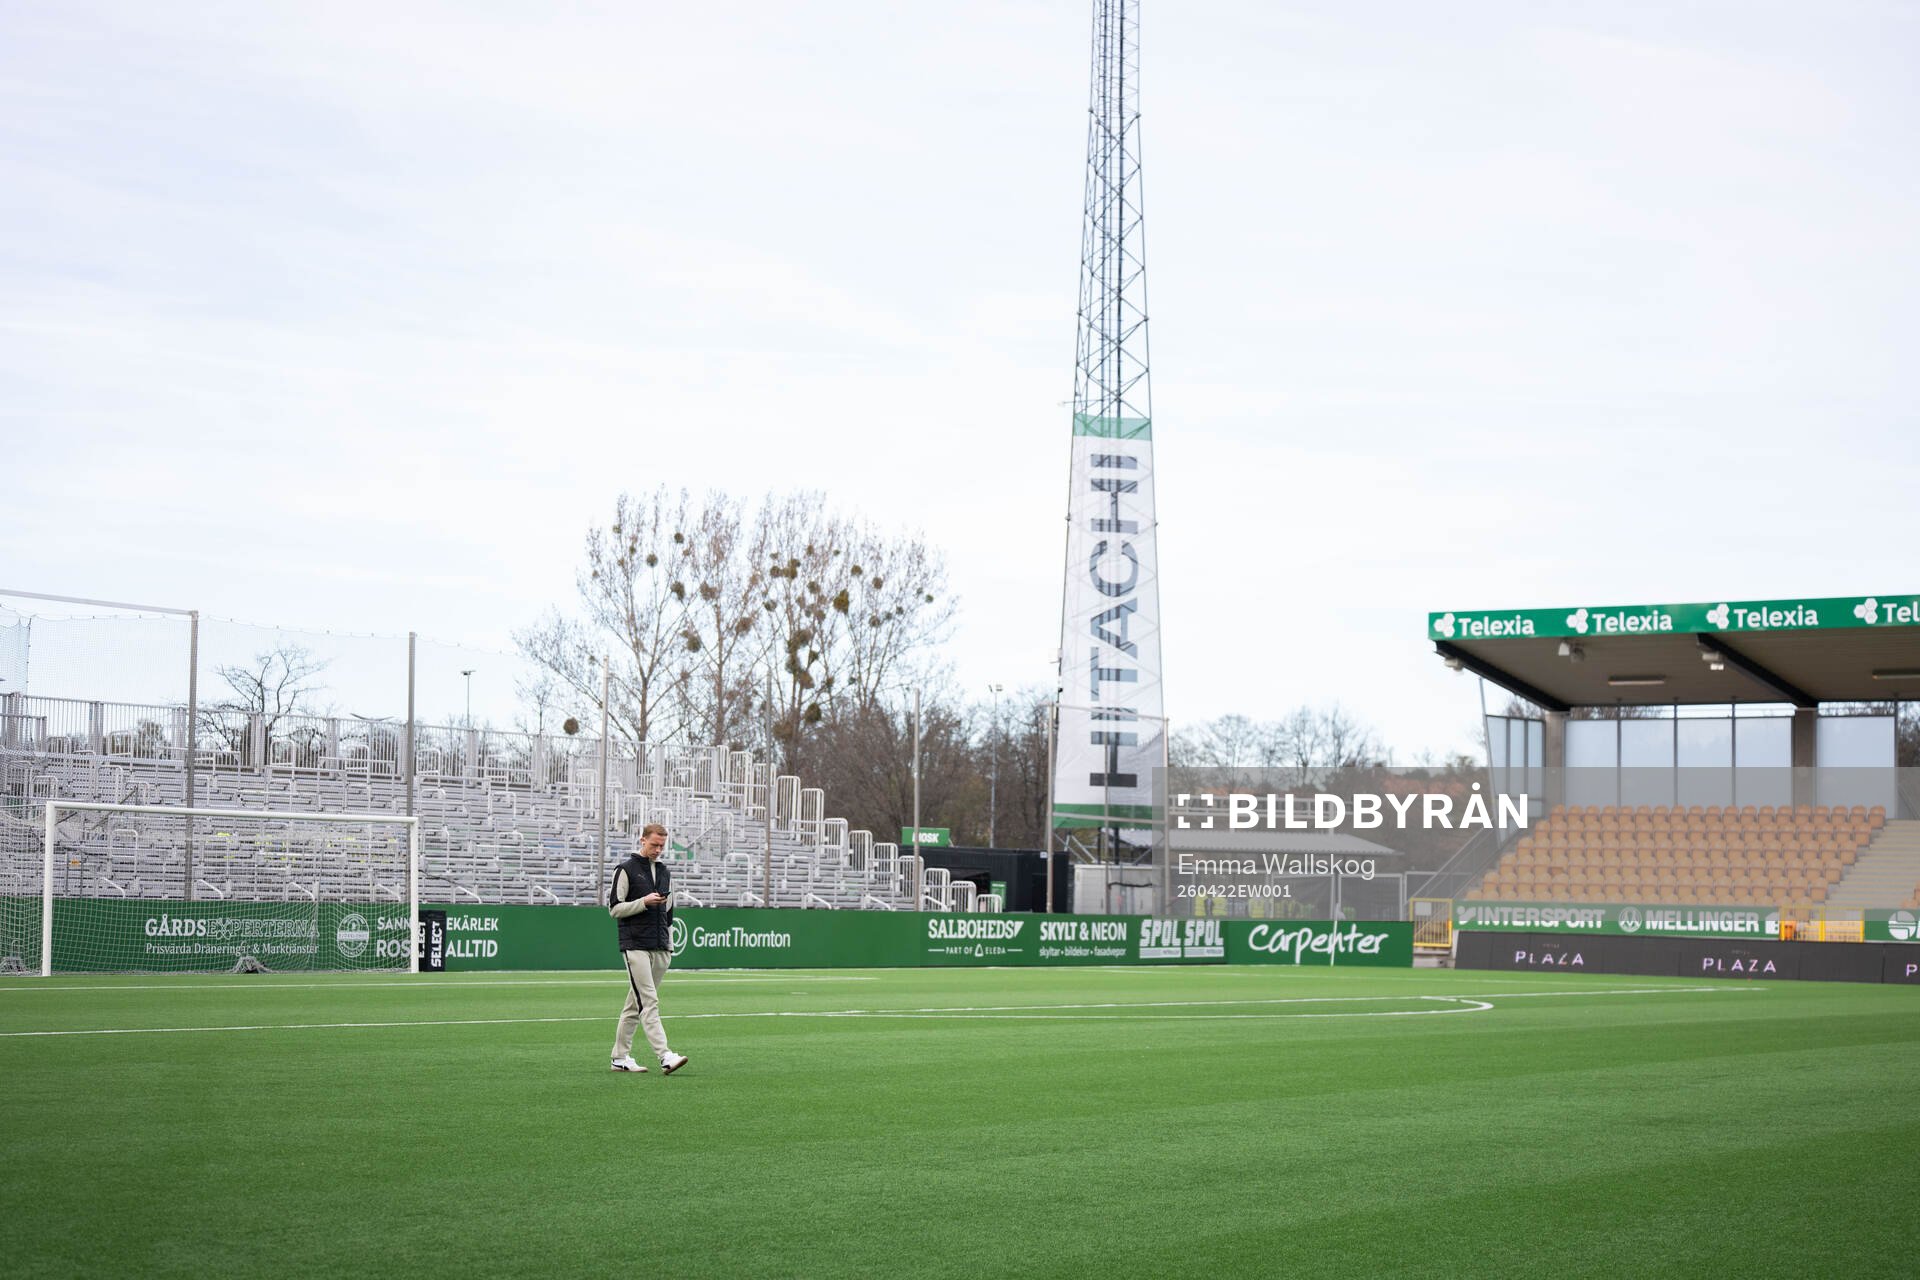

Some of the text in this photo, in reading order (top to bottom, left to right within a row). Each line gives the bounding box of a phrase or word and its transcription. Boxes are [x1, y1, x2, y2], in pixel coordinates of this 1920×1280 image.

[1089, 453, 1139, 788] HITACHI
[1458, 614, 1535, 636] Telexia
[1592, 610, 1673, 633] Telexia
[1733, 604, 1819, 628] Telexia
[1477, 906, 1606, 928] INTERSPORT
[1645, 910, 1760, 932] MELLINGER
[418, 921, 426, 958] ELECT
[692, 926, 791, 948] Grant Thornton
[928, 919, 1015, 939] SALBOHEDS
[1040, 922, 1127, 941] SKYLT & NEON
[1139, 919, 1224, 947] SPOL SPOL
[431, 921, 442, 967] SELECT
[445, 939, 498, 957] ALLTID
[1248, 924, 1389, 964] Carpenter
[1702, 958, 1777, 973] PLAZA
